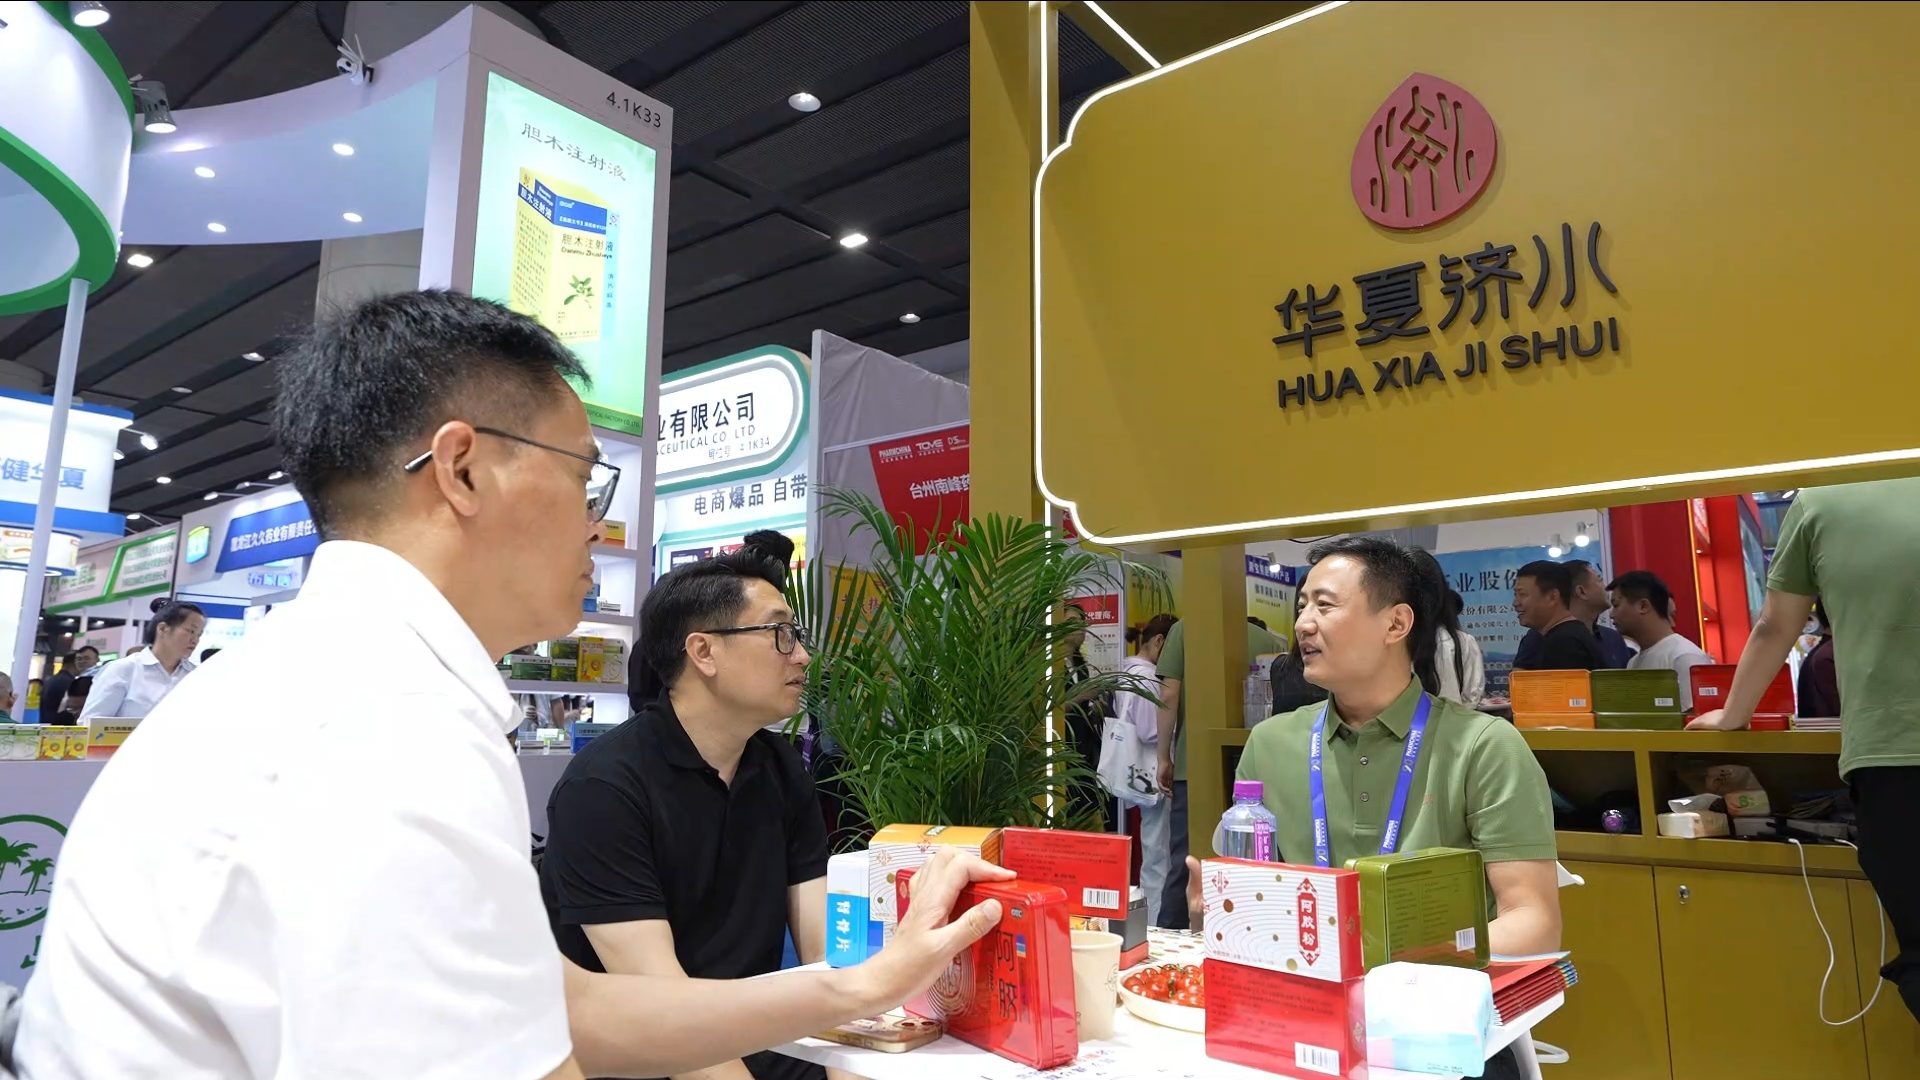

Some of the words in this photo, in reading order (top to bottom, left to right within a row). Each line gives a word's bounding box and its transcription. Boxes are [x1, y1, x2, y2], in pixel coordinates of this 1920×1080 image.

[606, 91, 662, 129] 4.1K33
[521, 122, 627, 182] 胆木注射液
[1272, 221, 1618, 357] 华夏济水
[1278, 367, 1364, 409] HUA
[1373, 351, 1446, 393] XIA
[1454, 341, 1488, 378] JI
[1500, 317, 1620, 368] SHUI
[656, 435, 709, 456] CEUTICAL
[694, 482, 764, 515] 电商爆品
[1445, 568, 1519, 592] 业股份
[1460, 604, 1515, 616] 份有限公
[1300, 899, 1316, 947] 阿胶粉
